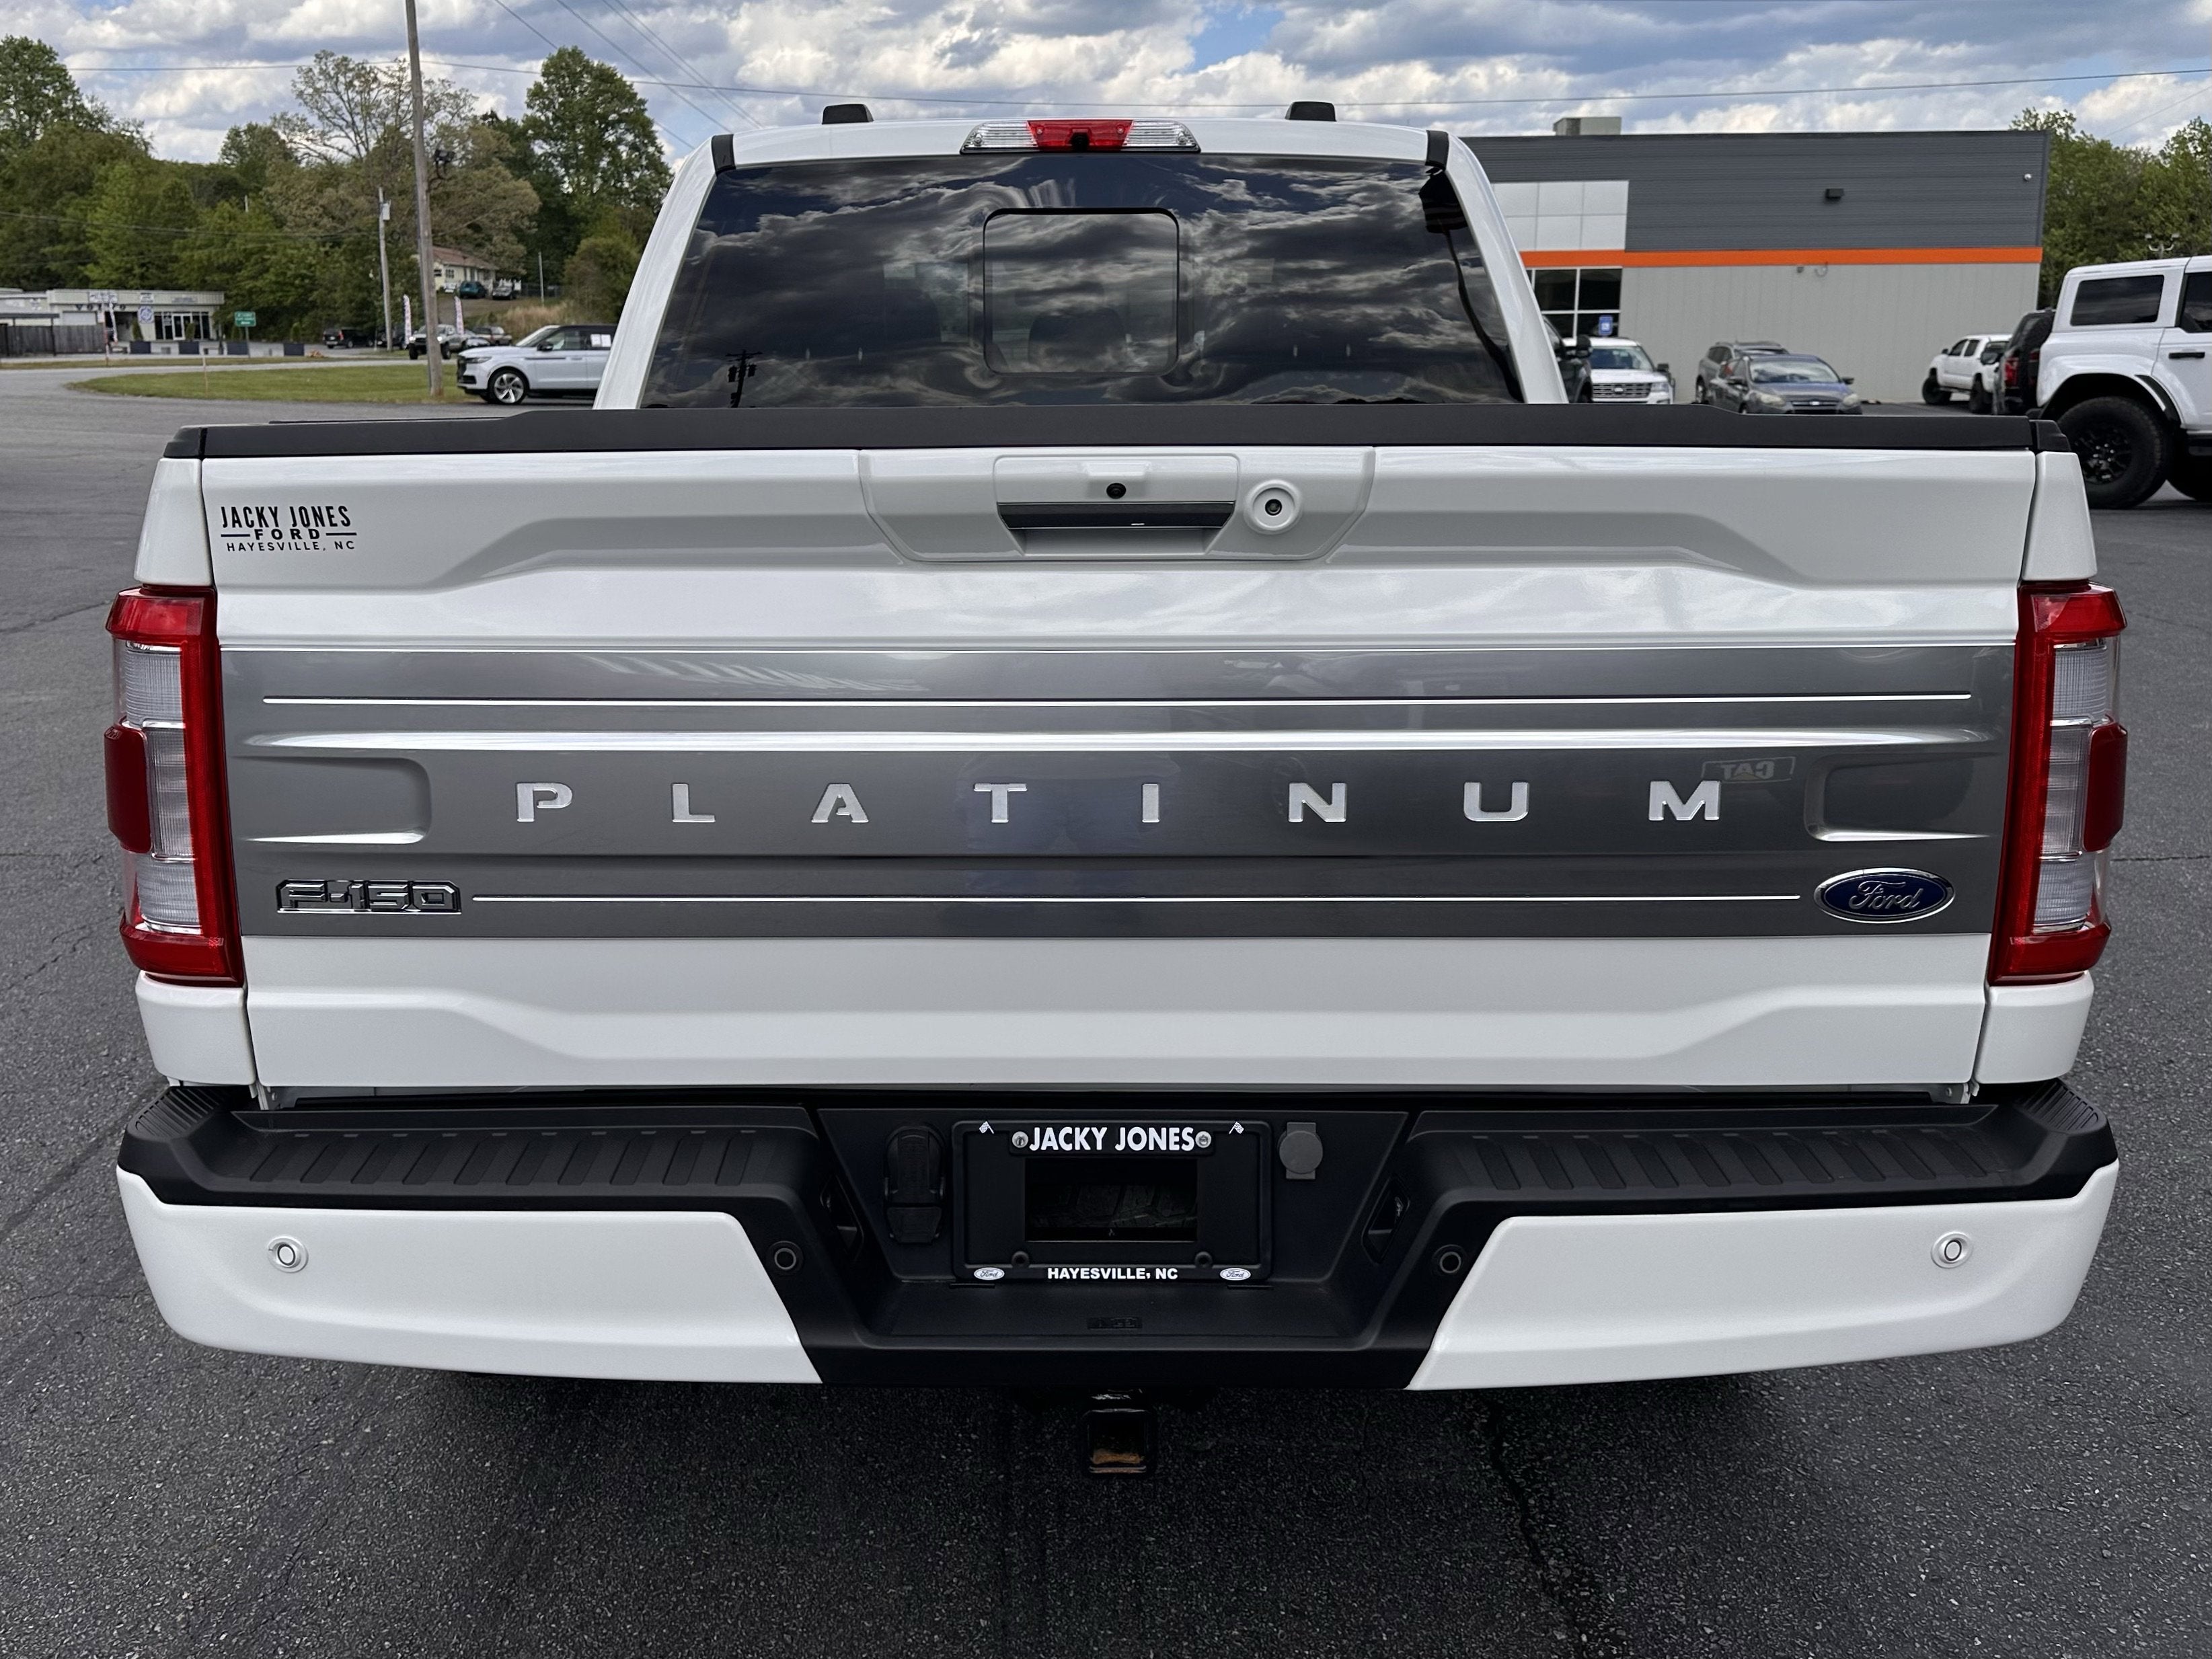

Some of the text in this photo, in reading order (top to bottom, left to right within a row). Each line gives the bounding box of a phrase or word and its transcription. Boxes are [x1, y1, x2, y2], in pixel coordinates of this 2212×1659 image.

[221, 506, 351, 529] JACKY JONES
[226, 540, 355, 552] HAYESVILLE, NC
[254, 528, 320, 541] FORD
[516, 781, 1720, 823] PLATINUM
[276, 878, 462, 915] F-150
[1847, 880, 1925, 912] Ford
[1029, 1126, 1195, 1151] JACKY JONES
[1047, 1268, 1178, 1280] HAYESVILLE, NC
